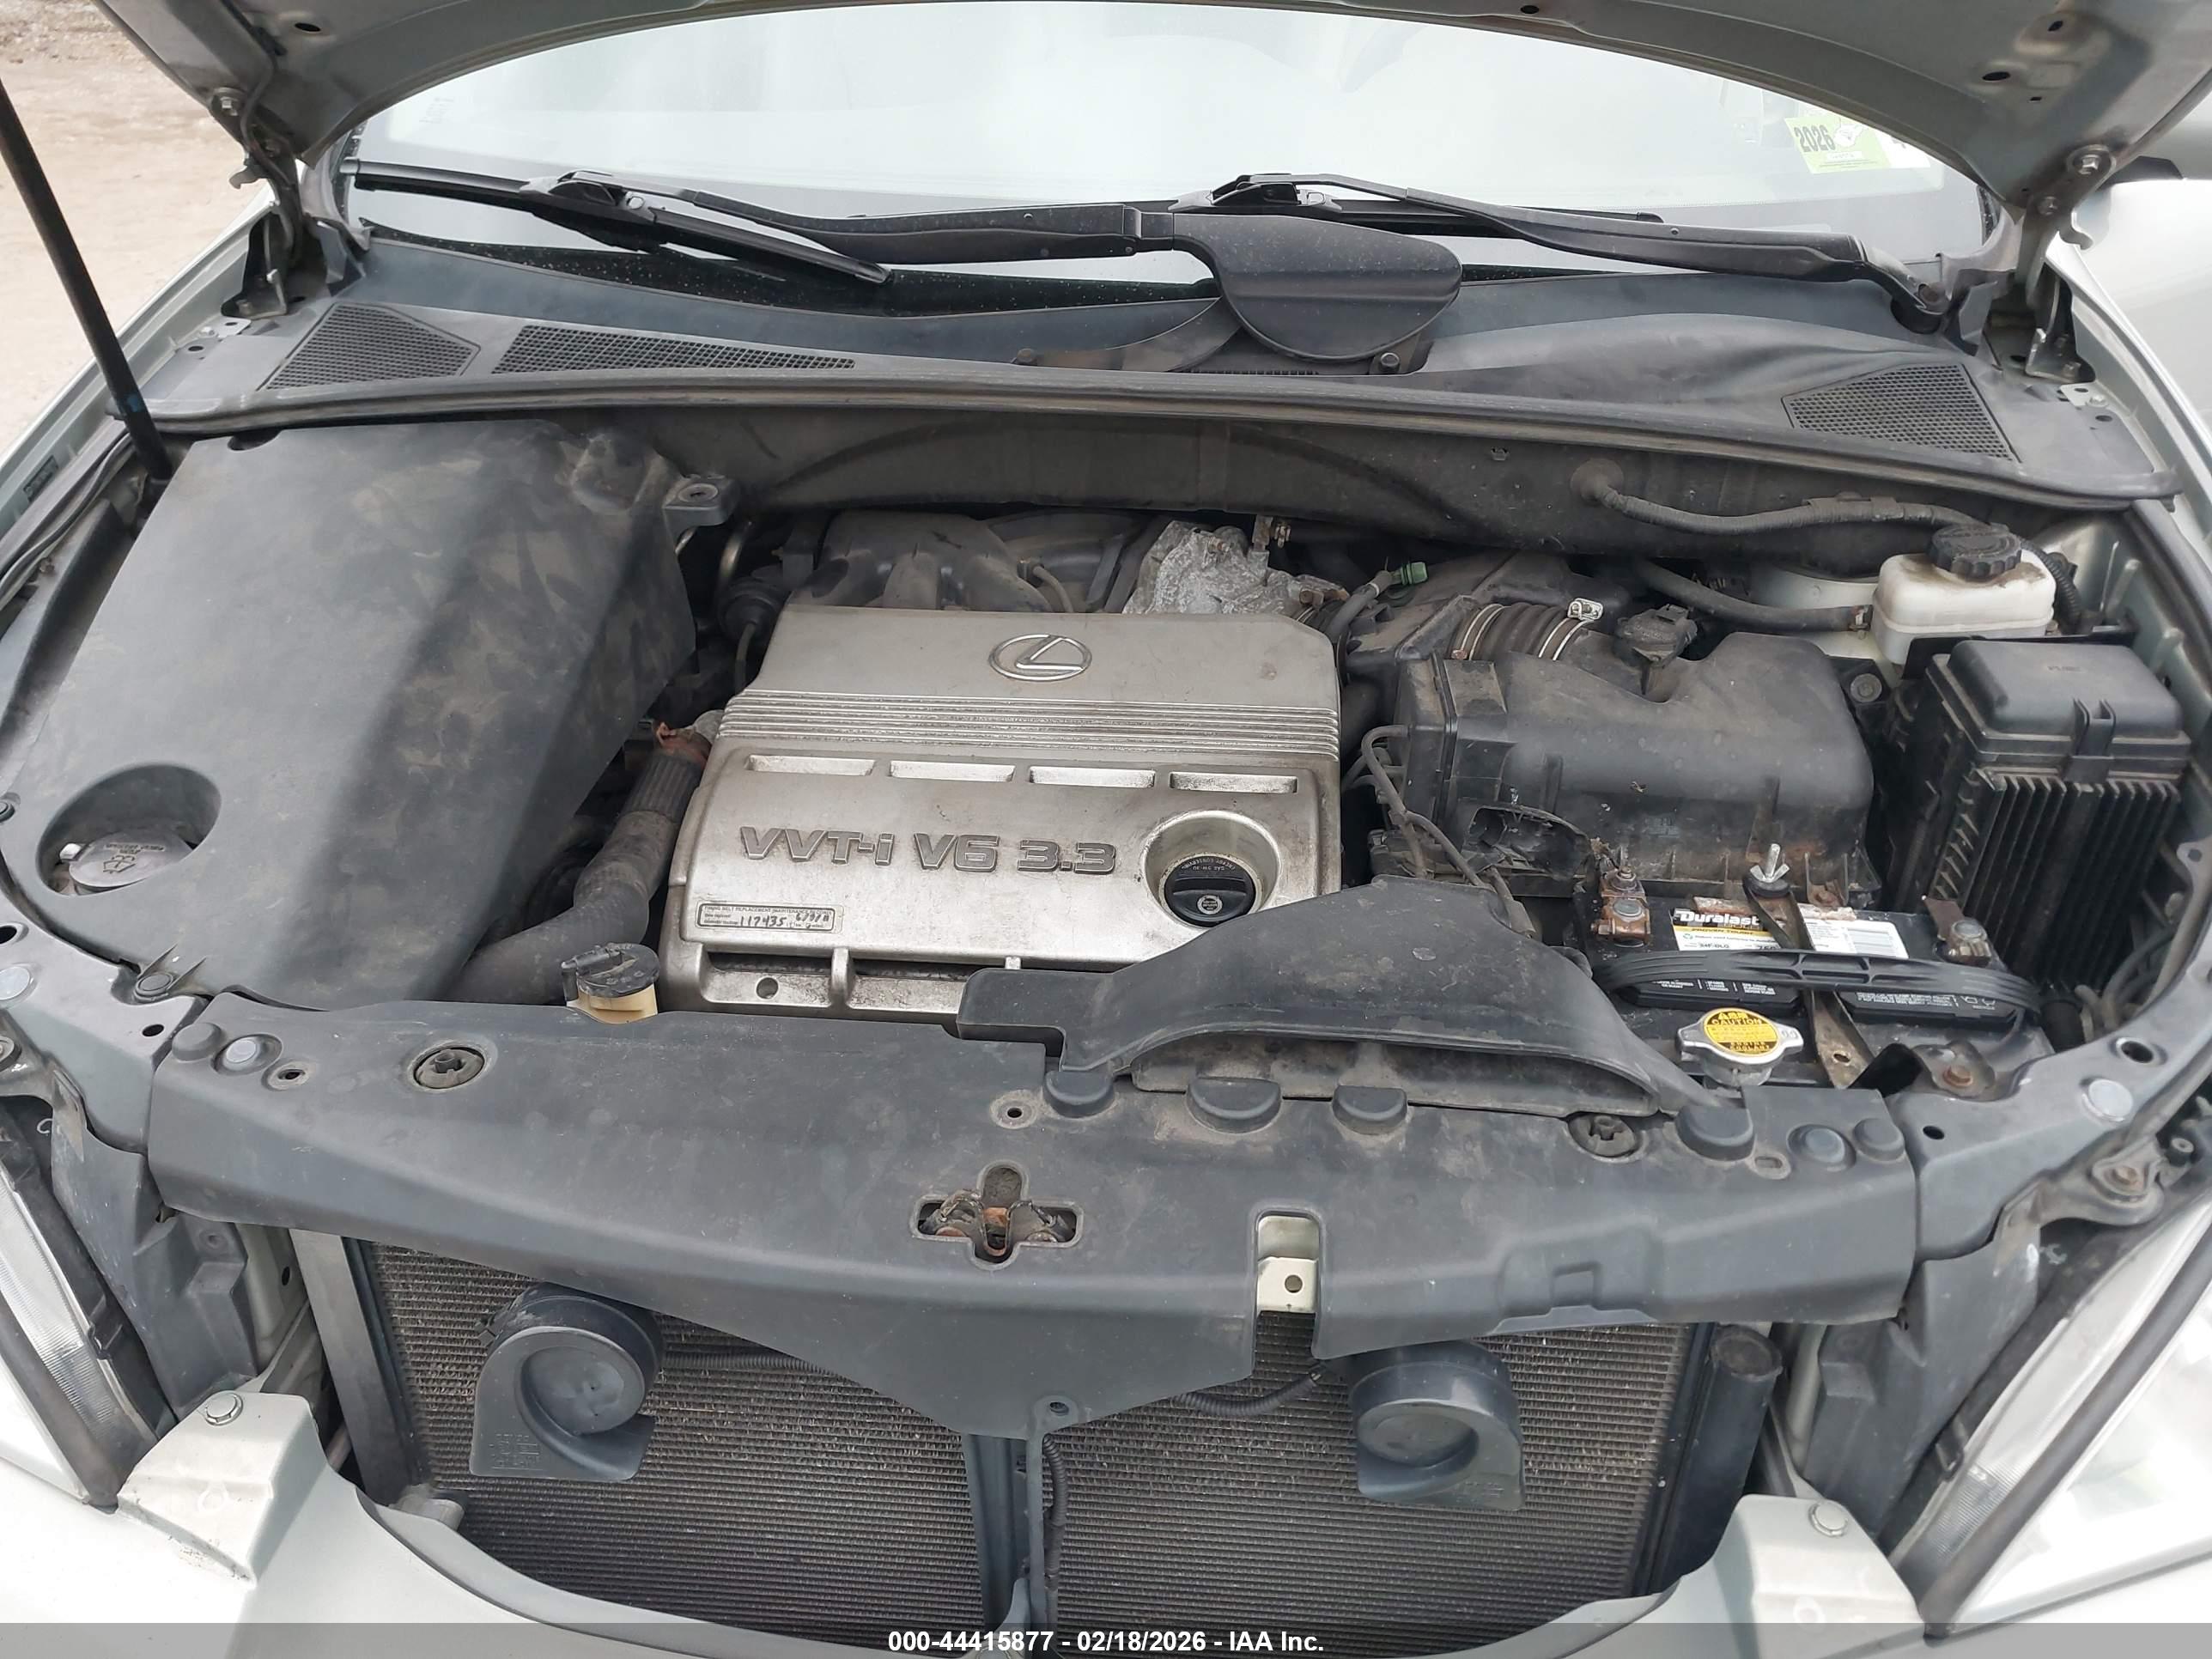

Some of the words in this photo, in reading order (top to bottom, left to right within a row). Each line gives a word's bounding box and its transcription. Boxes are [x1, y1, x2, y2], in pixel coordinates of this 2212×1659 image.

[1794, 124, 1836, 152] 2026
[740, 825, 895, 866] VVT-i
[914, 832, 1001, 873] V6
[1016, 840, 1116, 875] 3.3
[1674, 908, 1759, 925] Duralast
